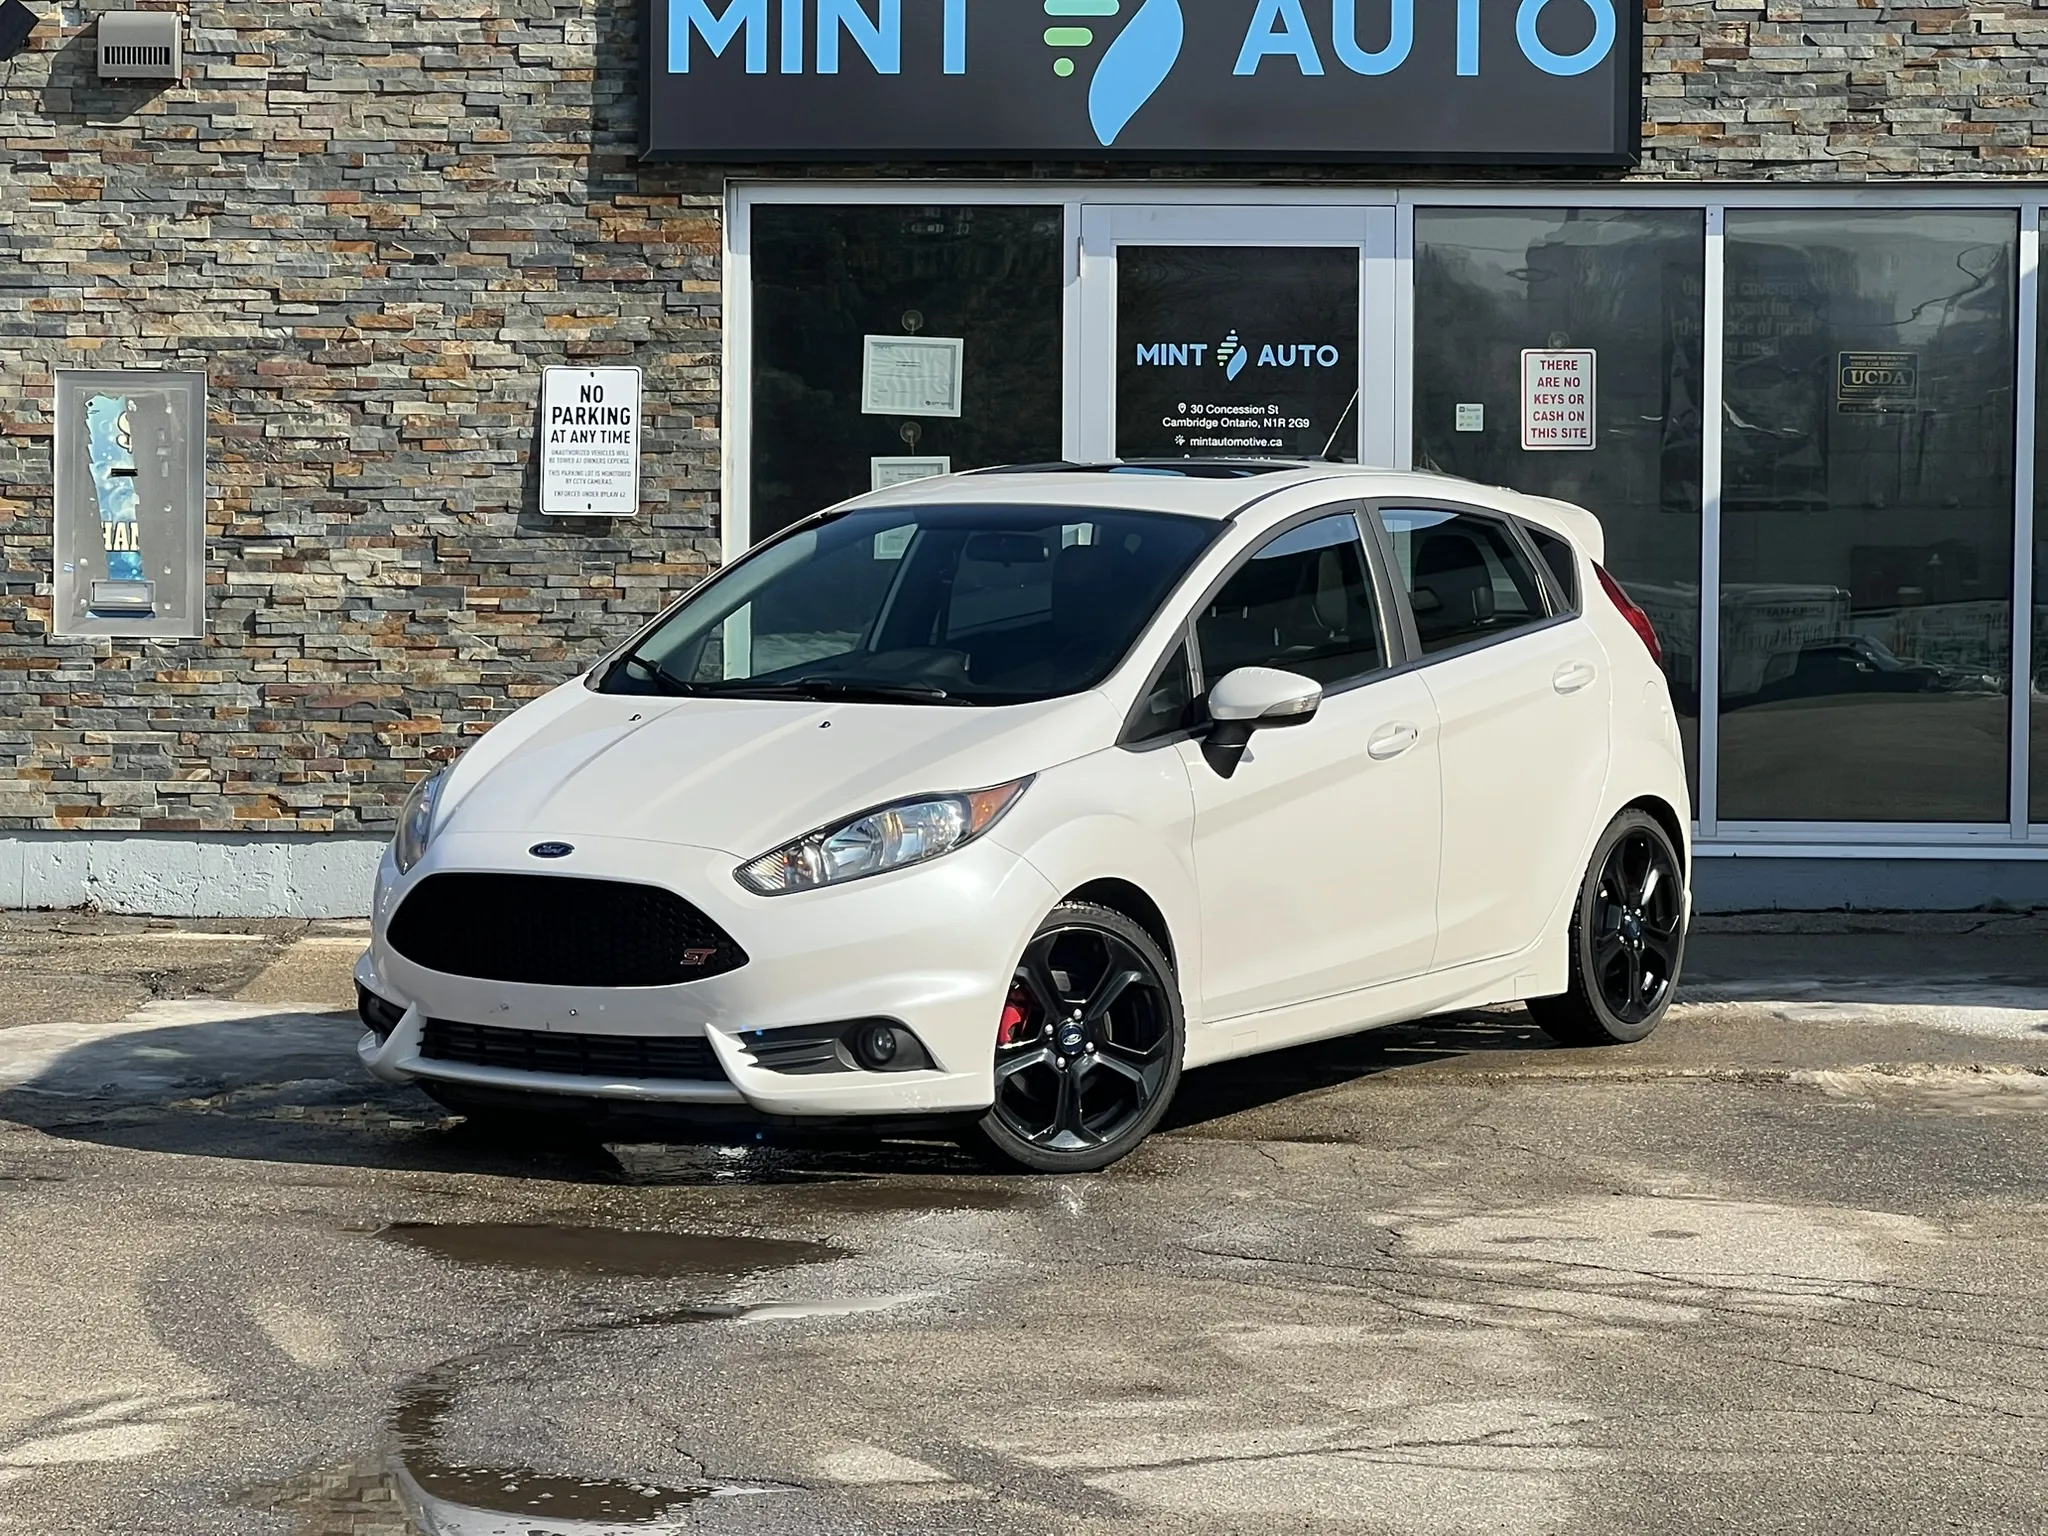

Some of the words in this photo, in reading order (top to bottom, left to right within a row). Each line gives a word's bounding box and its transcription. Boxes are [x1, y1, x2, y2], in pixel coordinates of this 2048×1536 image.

[1136, 343, 1208, 366] MINT
[1257, 344, 1339, 367] AUTO
[1539, 359, 1578, 371] THERE
[1537, 376, 1560, 388] ARE
[1563, 376, 1581, 388] NO
[1851, 370, 1907, 385] UCDA
[580, 384, 604, 404] NO
[1534, 393, 1565, 405] KEYS
[1568, 393, 1585, 405] OR
[1190, 404, 1204, 415] 30
[1205, 404, 1265, 415] Concession
[1267, 404, 1279, 415] St
[552, 406, 631, 426] PARKING
[1533, 410, 1564, 422] CASH
[1568, 410, 1585, 422] ON
[1162, 417, 1219, 430] Cambridge
[1220, 417, 1261, 429] Ontario,
[1263, 418, 1286, 428] N1R
[1288, 417, 1310, 429] 2G9
[550, 429, 567, 443] AT
[569, 429, 597, 444] ANY
[600, 430, 631, 444] TIME
[1530, 427, 1558, 439] THIS
[1561, 427, 1587, 439] SITE
[1189, 436, 1283, 447] mintautomotive.ca
[680, 948, 717, 965] ST
